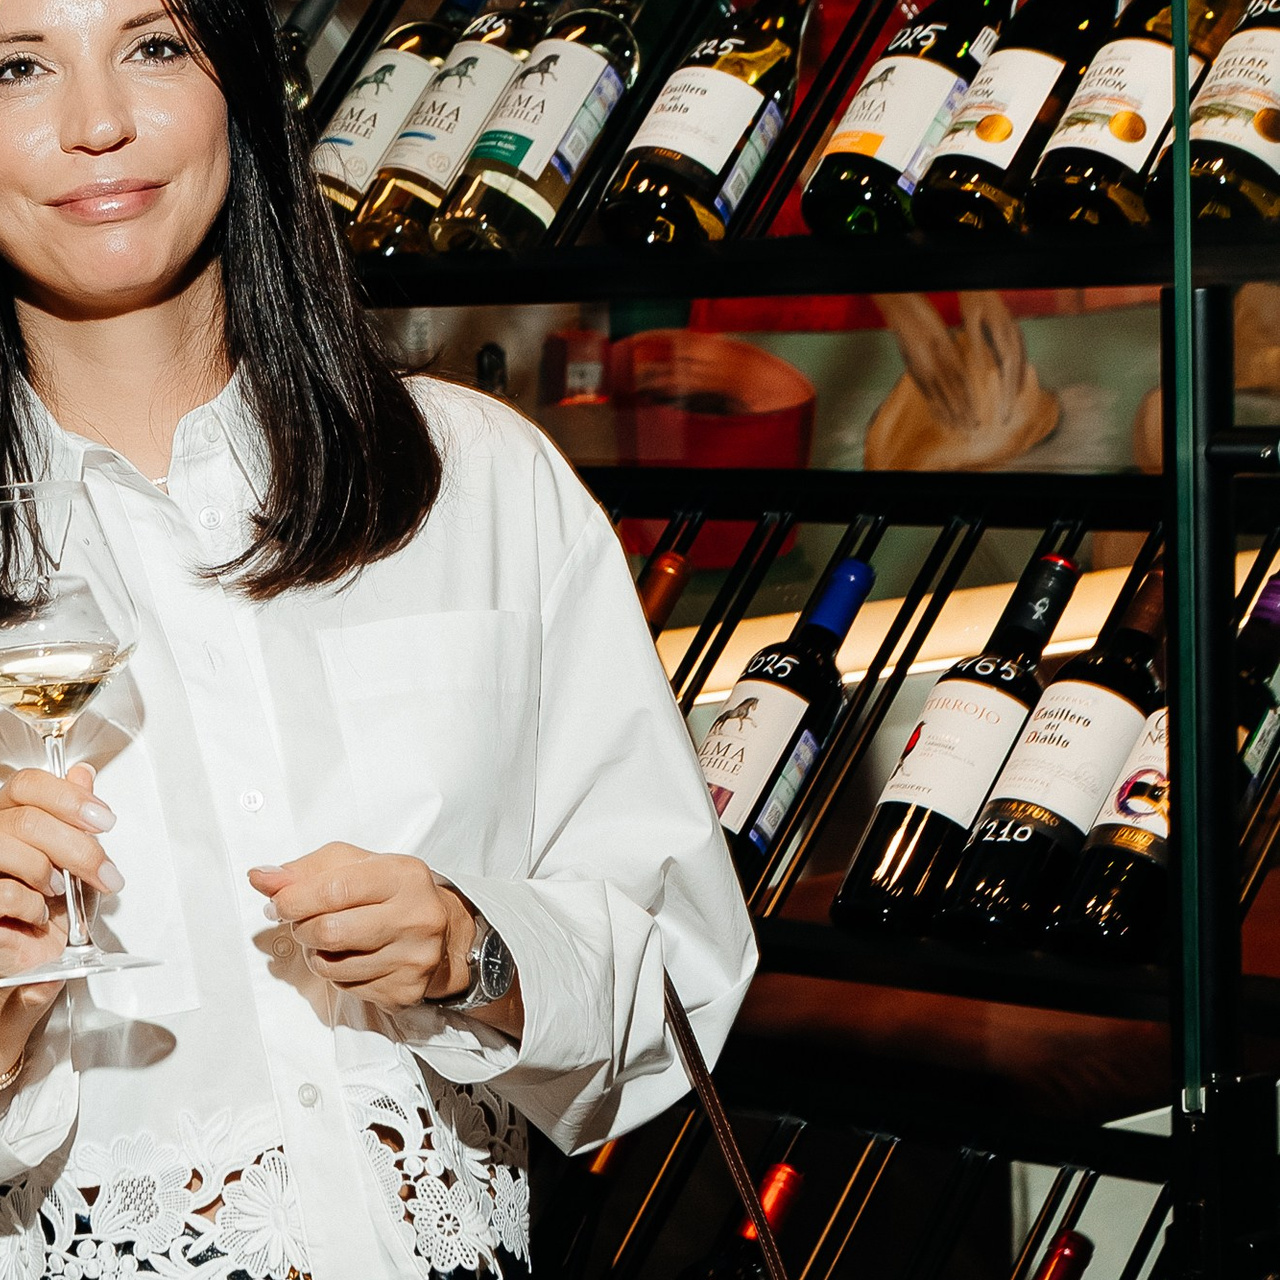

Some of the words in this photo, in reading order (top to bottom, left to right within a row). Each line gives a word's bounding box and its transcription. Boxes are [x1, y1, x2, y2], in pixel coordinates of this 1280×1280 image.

[415, 100, 461, 122] LMA
[502, 94, 546, 114] LMA
[335, 106, 378, 128] LMA
[925, 696, 1001, 726] TIRROJO
[1033, 706, 1092, 728] Casillero
[1044, 721, 1061, 732] del
[1024, 730, 1071, 749] Diablo
[700, 741, 746, 764] LMA
